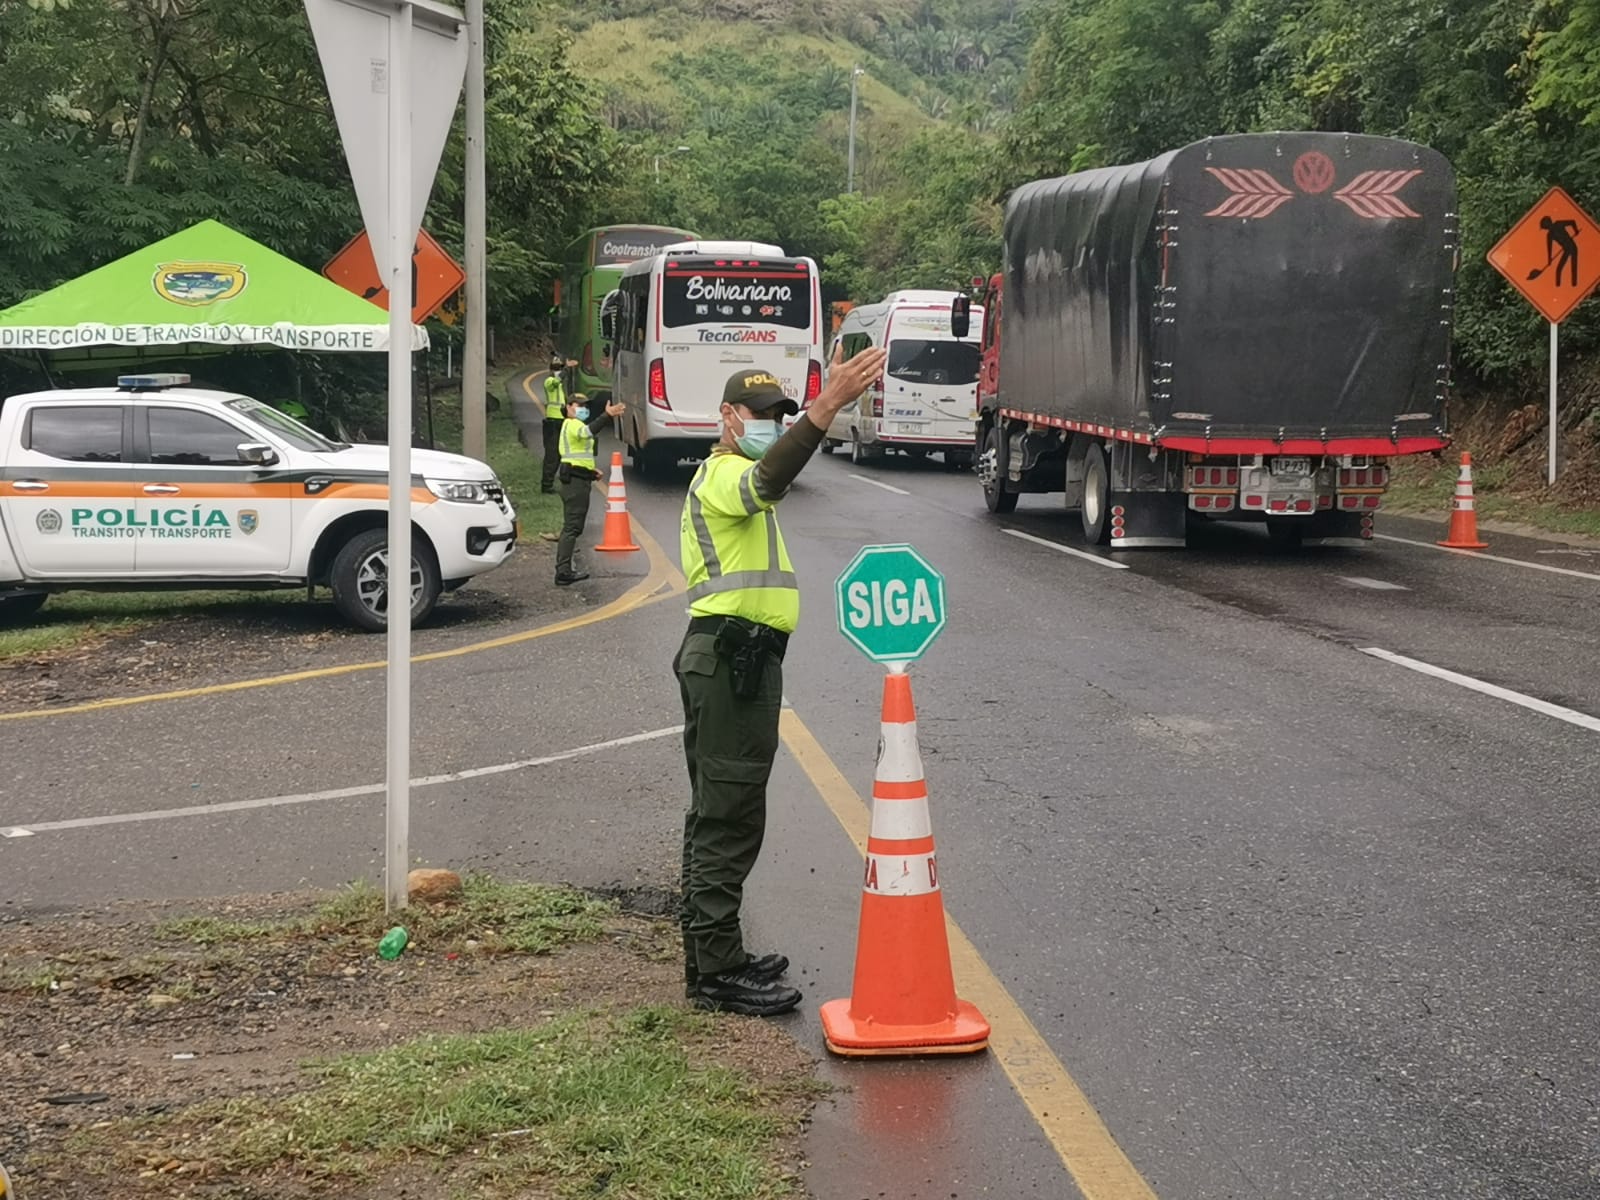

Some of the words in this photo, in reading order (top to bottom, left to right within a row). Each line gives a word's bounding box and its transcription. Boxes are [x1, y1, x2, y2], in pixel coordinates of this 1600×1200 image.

[686, 276, 792, 301] Bolivariano
[2, 326, 106, 345] DIRECCIÓN
[112, 328, 137, 343] DE
[233, 326, 247, 342] Y
[251, 327, 373, 348] TRANSPORTE
[697, 329, 777, 342] TecnoVANS
[71, 504, 231, 526] POLICÍA
[72, 528, 134, 538] TRANSITO
[137, 528, 146, 538] Y
[150, 528, 232, 538] TRANSPORTE
[847, 578, 937, 628] SIGA
